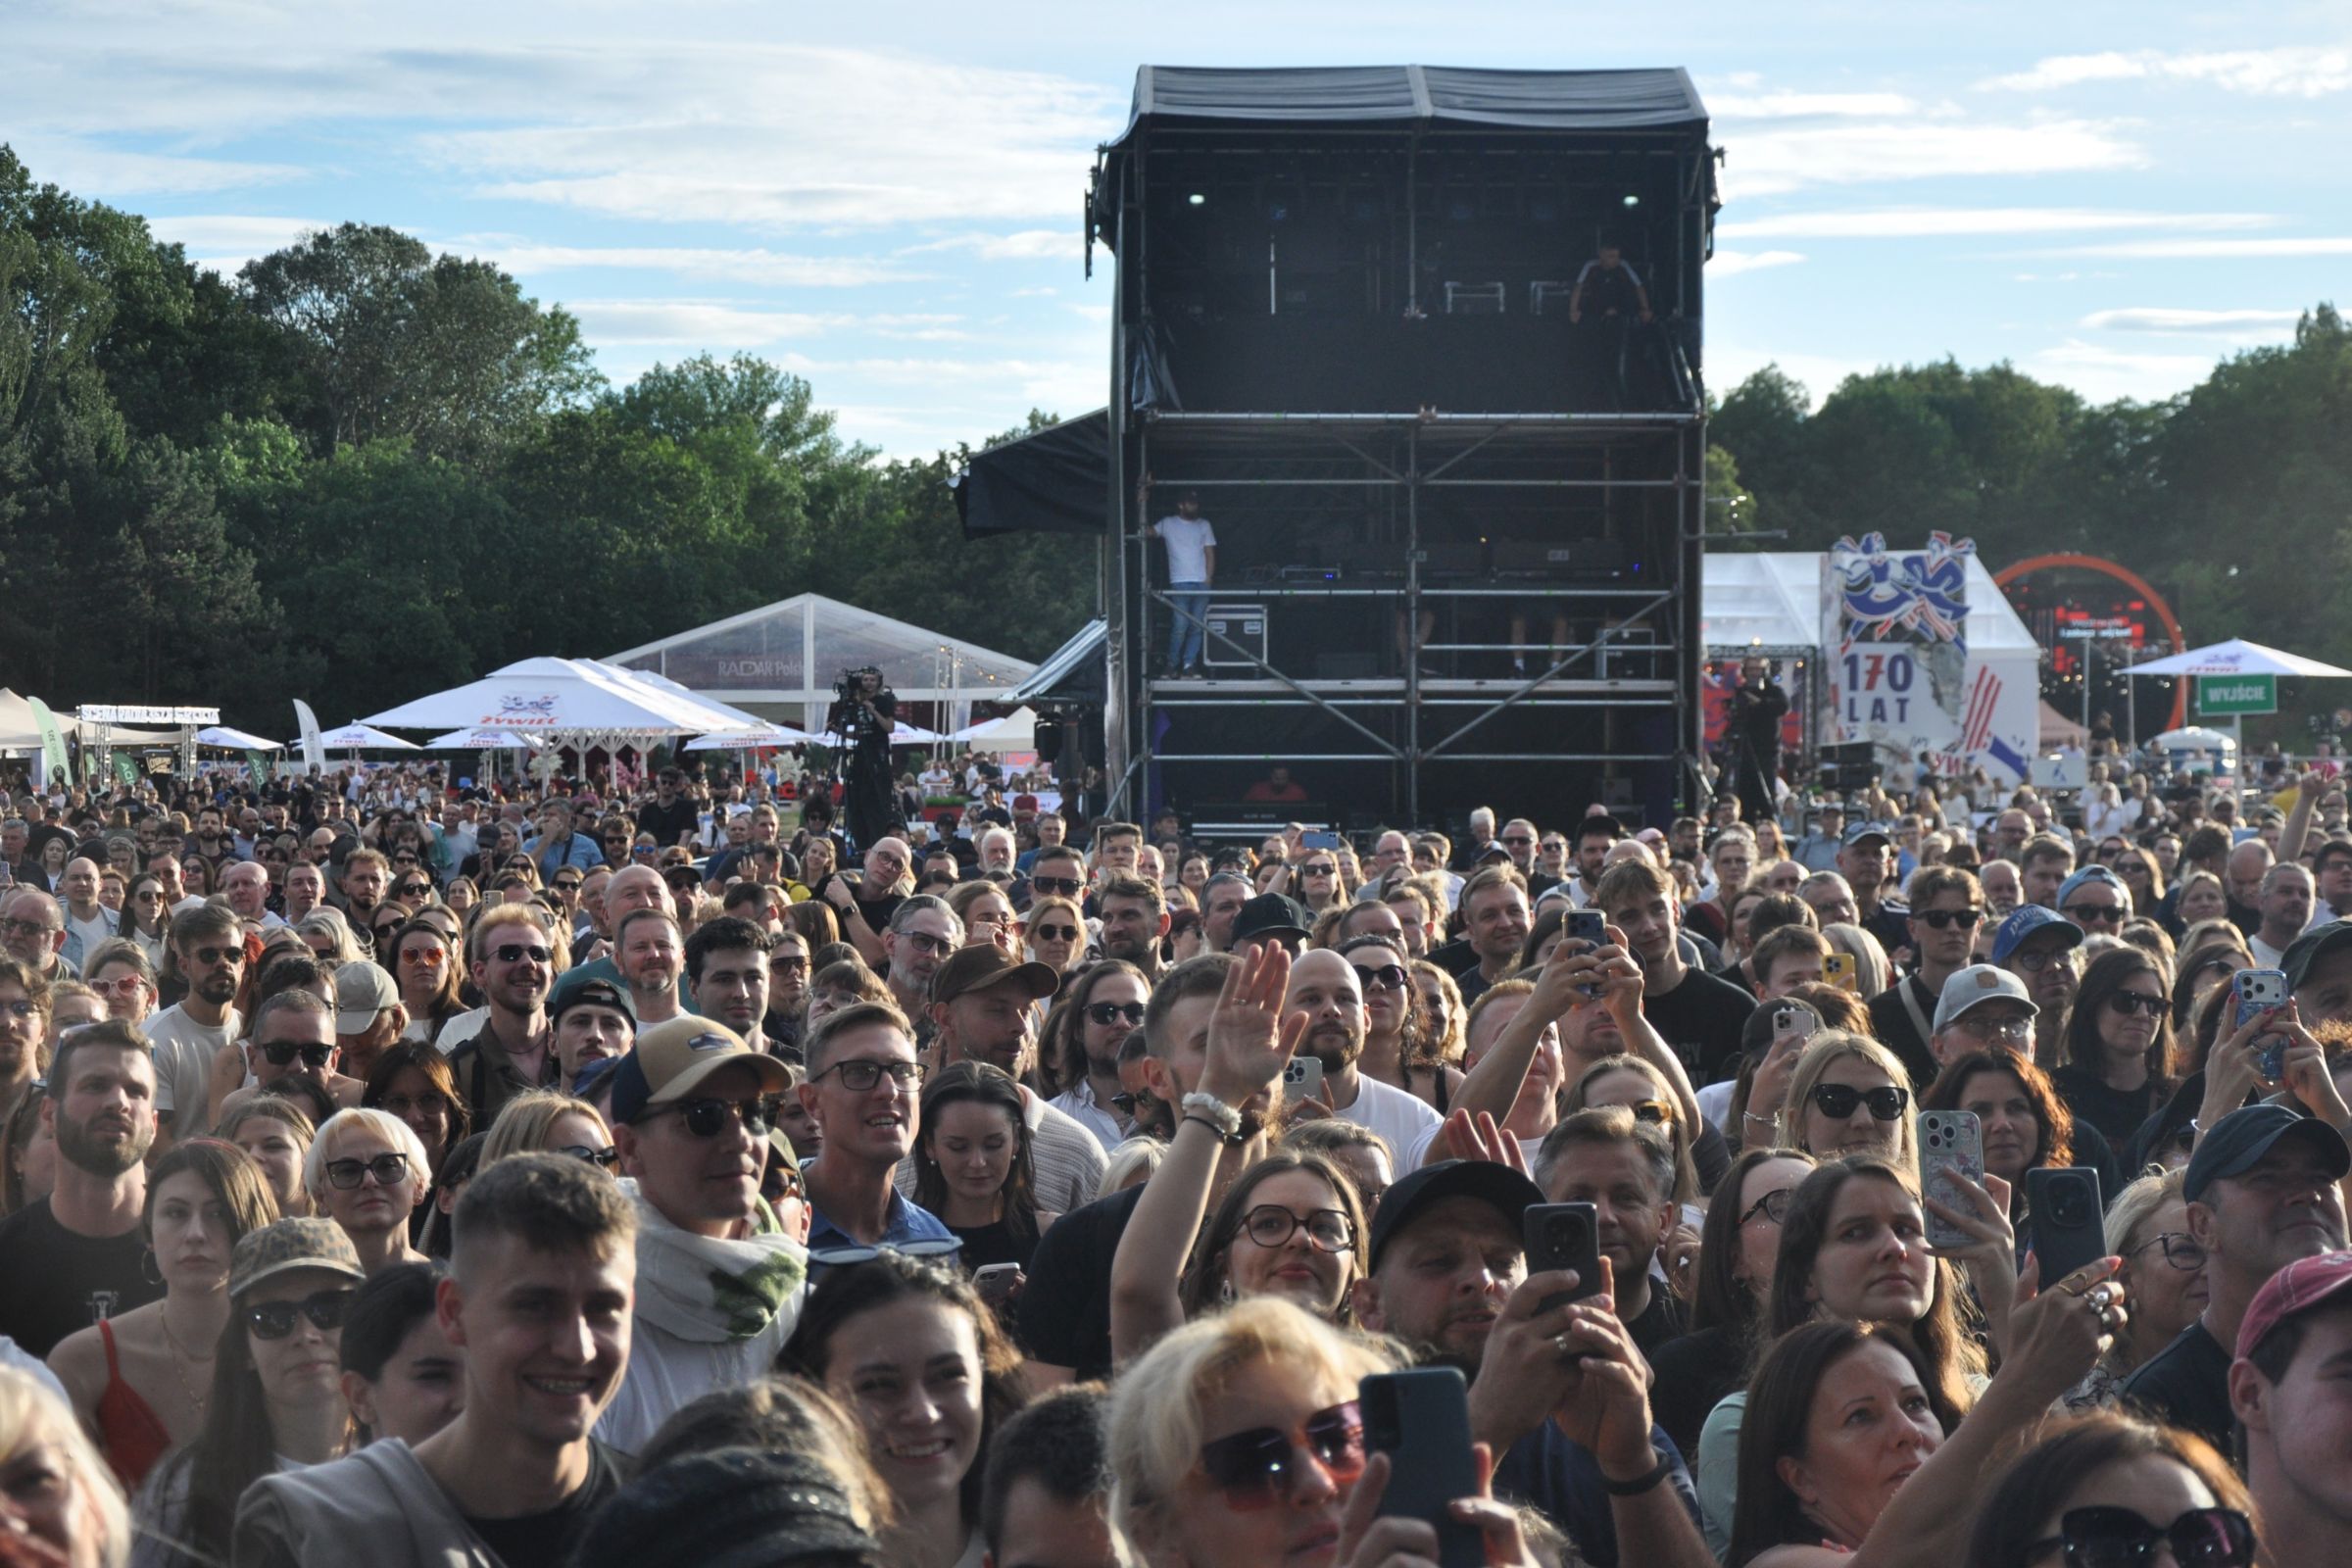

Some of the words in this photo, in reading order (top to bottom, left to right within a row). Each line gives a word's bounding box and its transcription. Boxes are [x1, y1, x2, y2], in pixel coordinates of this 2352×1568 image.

[718, 661, 773, 676] RADAR
[1843, 654, 1913, 692] 170
[2208, 682, 2267, 703] WYJŚCIE
[1848, 697, 1910, 723] LAT
